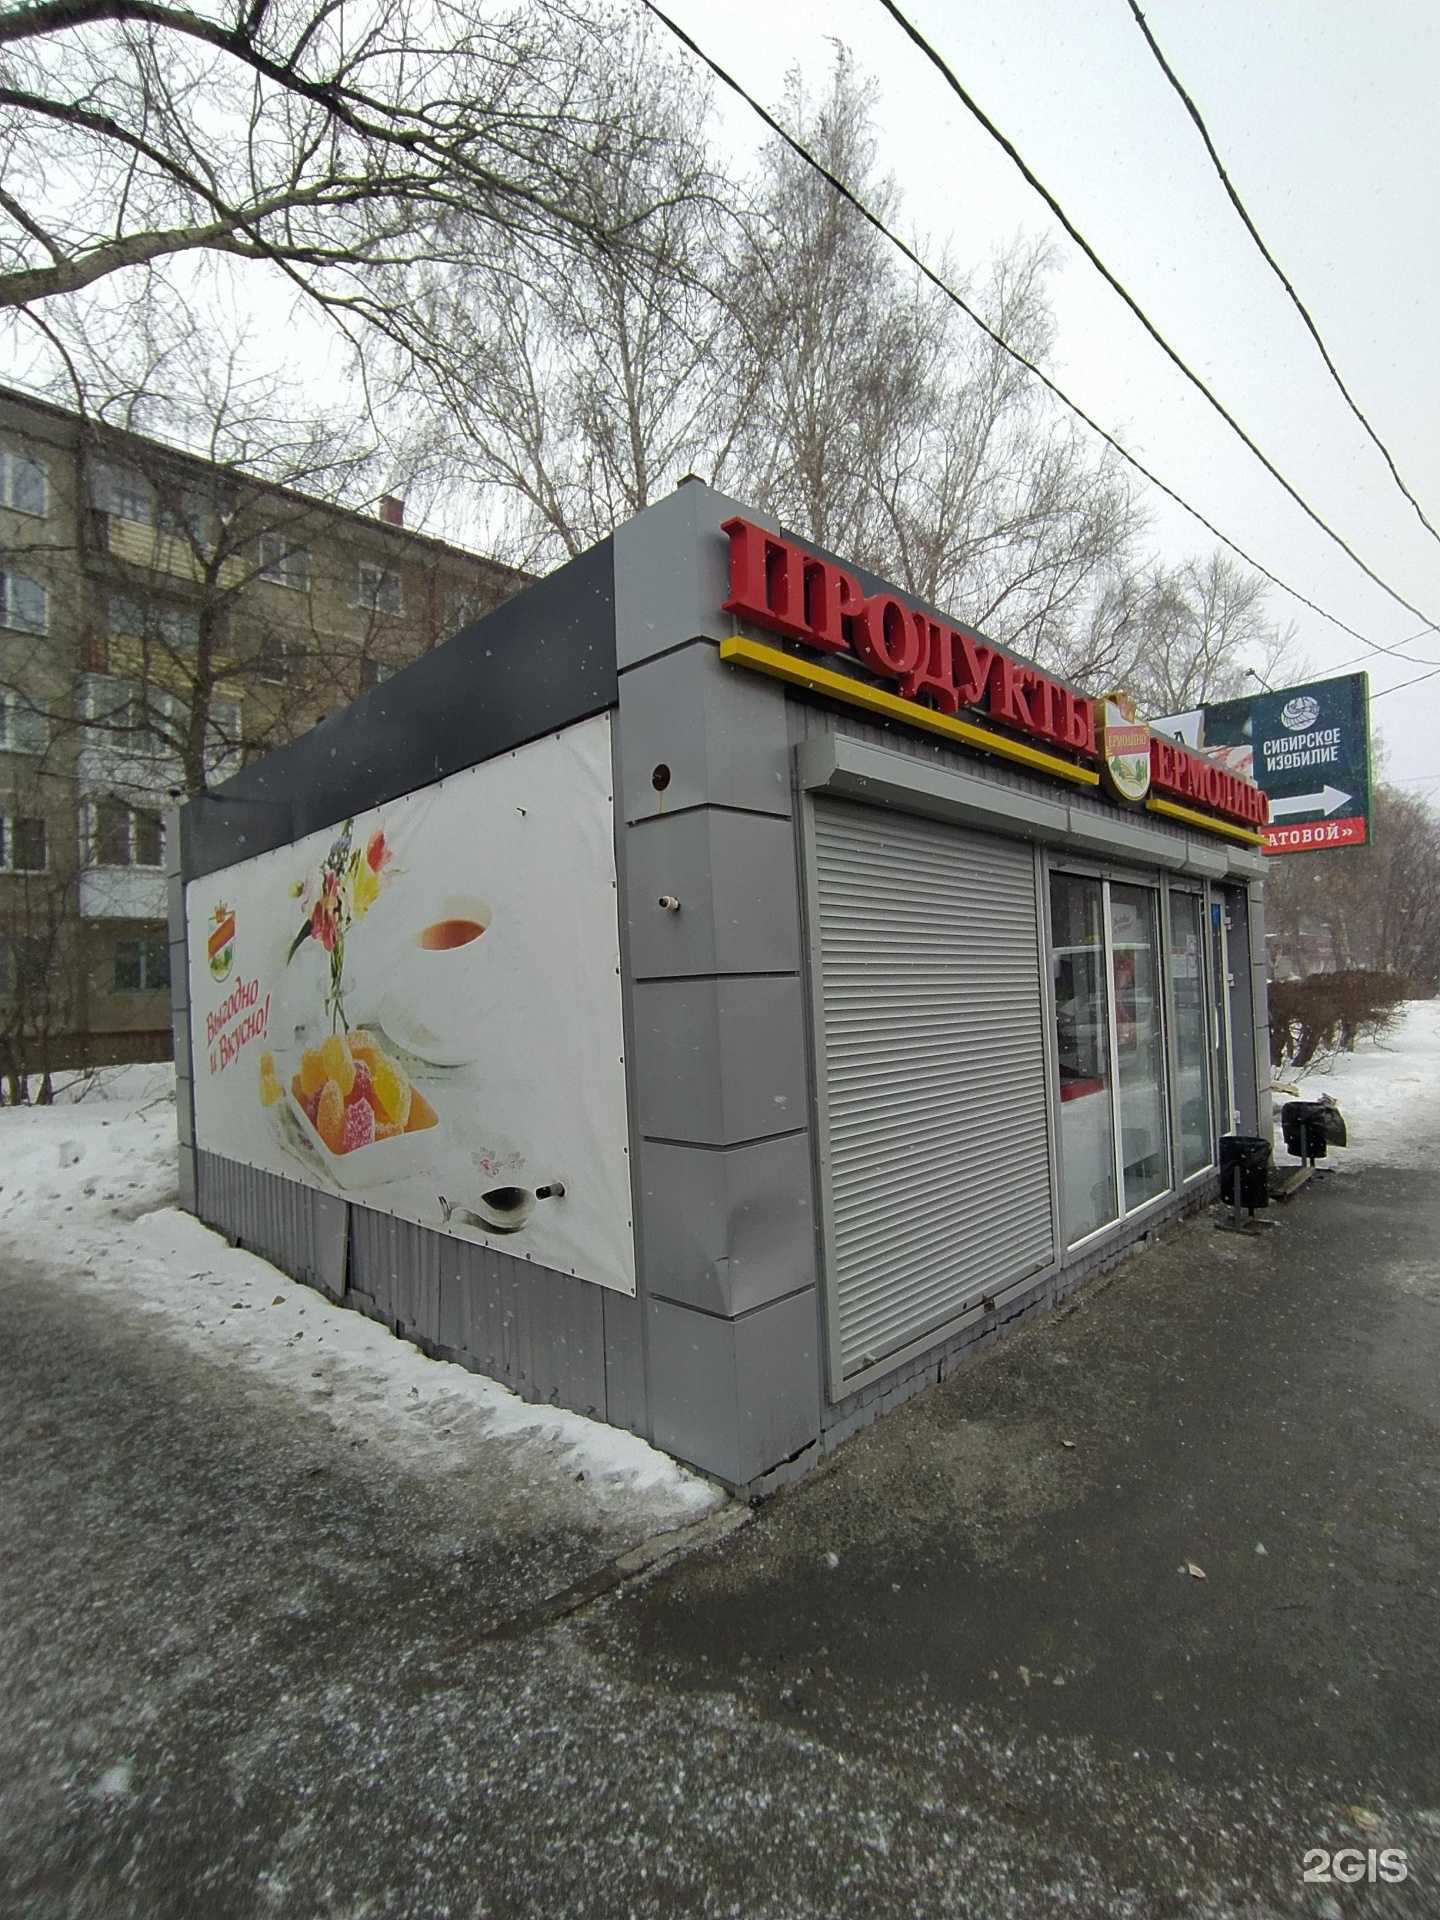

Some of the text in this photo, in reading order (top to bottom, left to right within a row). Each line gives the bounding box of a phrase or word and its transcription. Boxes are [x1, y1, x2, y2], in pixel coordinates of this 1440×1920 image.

[721, 516, 1099, 758] ПРОДУКТЫ
[1263, 727, 1341, 756] СИБИРСКОЕ
[1266, 745, 1339, 772] ИЗОБИЛИЕ
[1151, 736, 1269, 826] ЕРМОЛИНО
[1261, 822, 1353, 847] АТОВОЙ»
[206, 975, 259, 1047] Выгодно
[210, 993, 271, 1075] и Вкусно!
